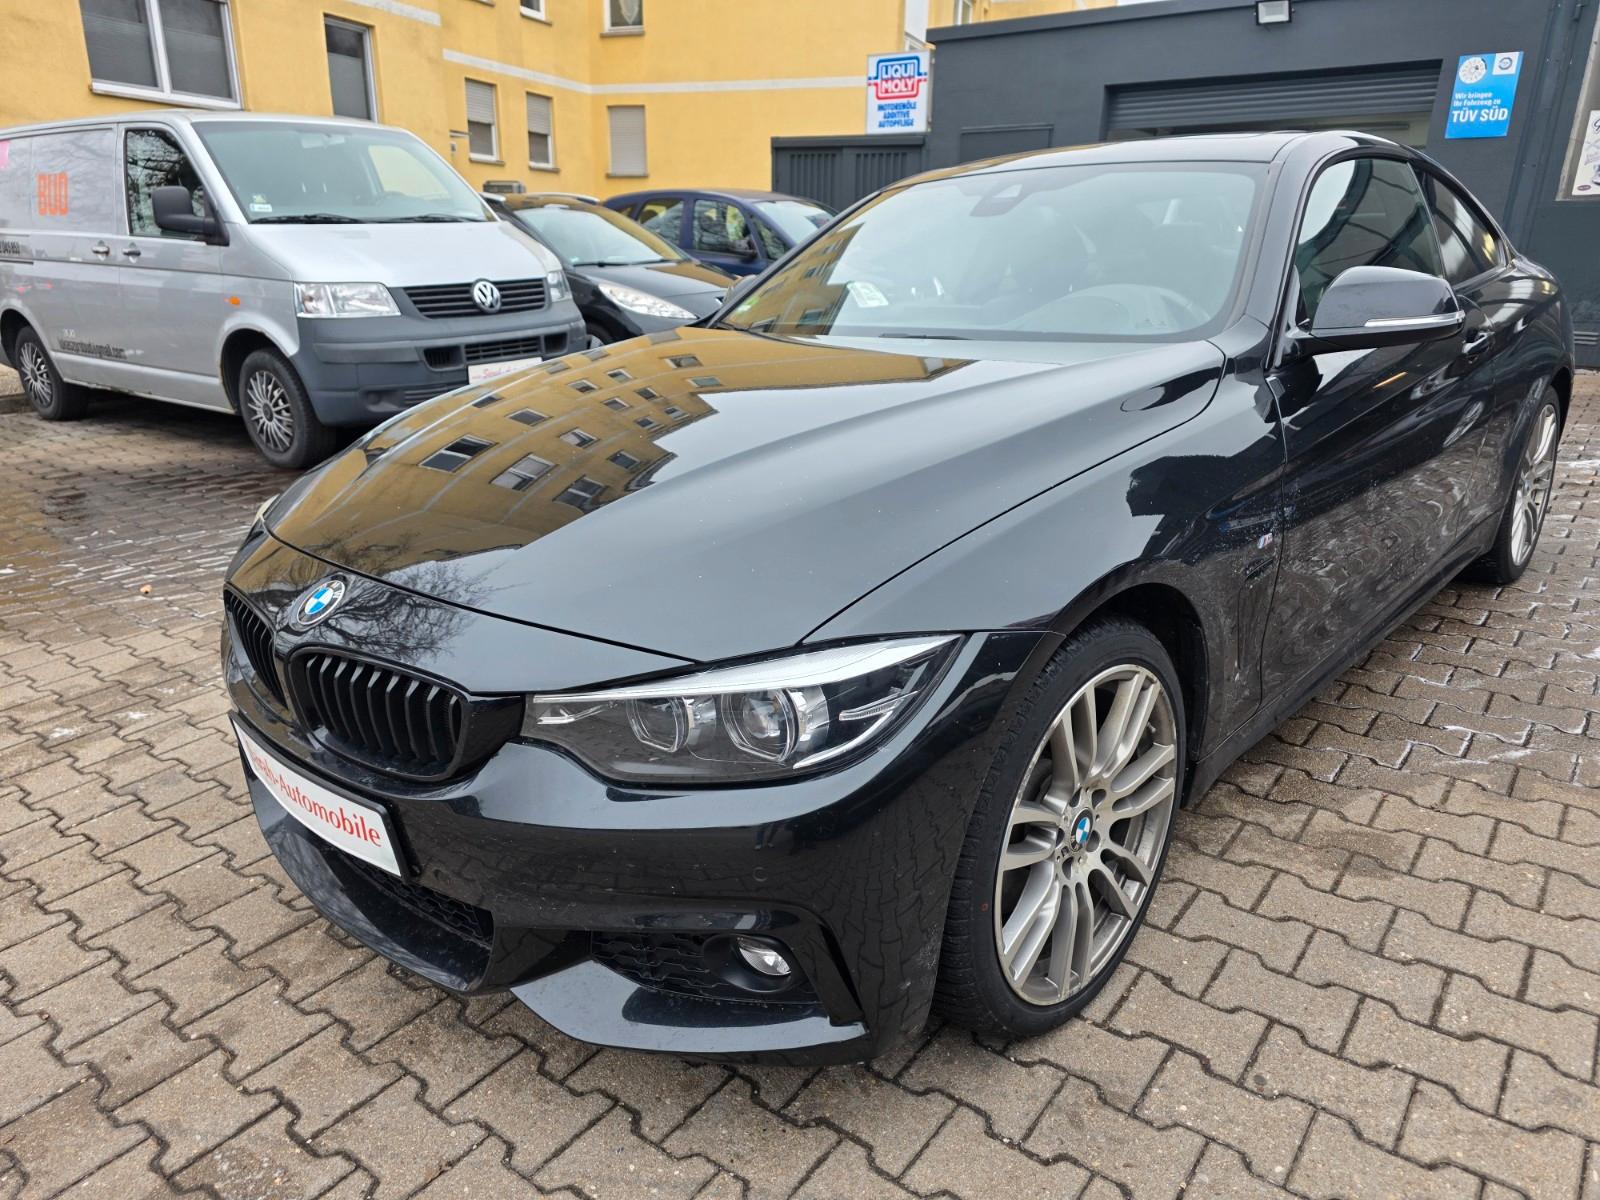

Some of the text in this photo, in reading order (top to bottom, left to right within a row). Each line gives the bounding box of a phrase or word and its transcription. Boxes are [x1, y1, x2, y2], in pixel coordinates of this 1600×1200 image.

[882, 64, 914, 78] LIQUI
[882, 79, 914, 93] MOLY
[1452, 106, 1508, 122] TÜV SÜD
